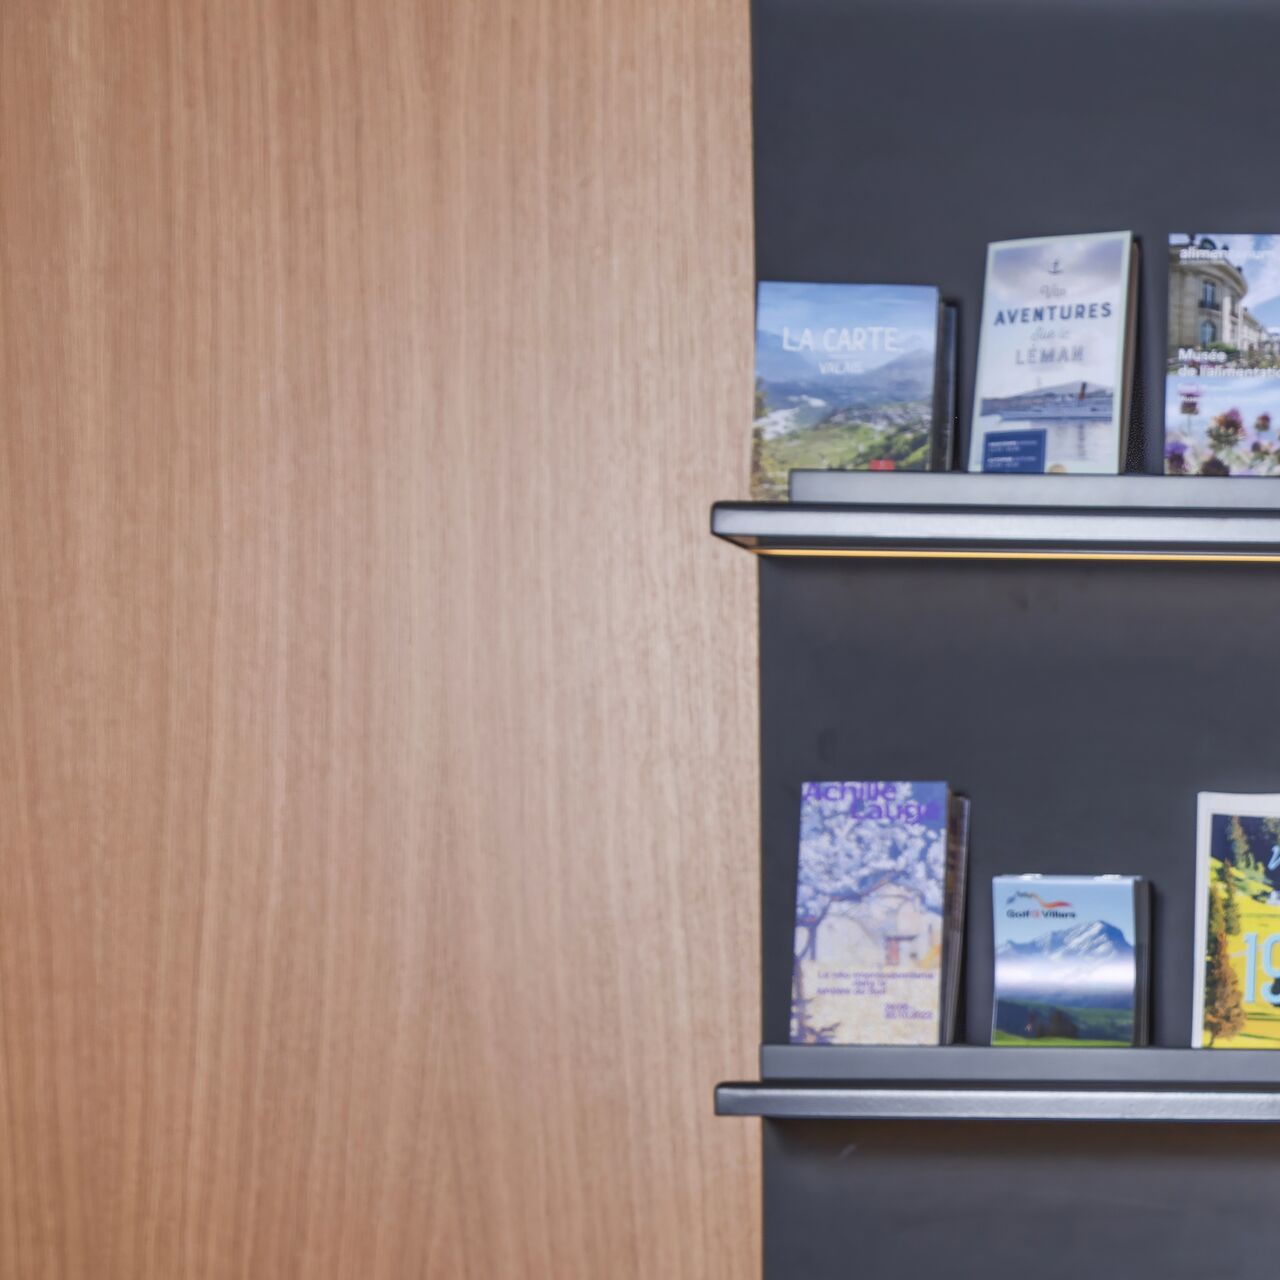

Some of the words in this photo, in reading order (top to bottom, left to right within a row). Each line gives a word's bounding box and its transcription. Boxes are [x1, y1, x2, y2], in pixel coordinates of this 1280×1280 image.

[993, 302, 1113, 326] AVENTURES
[782, 326, 815, 352] LA
[824, 326, 904, 352] CARTE
[1177, 348, 1228, 363] Musée
[804, 782, 898, 801] Achille
[1006, 909, 1030, 919] Golf
